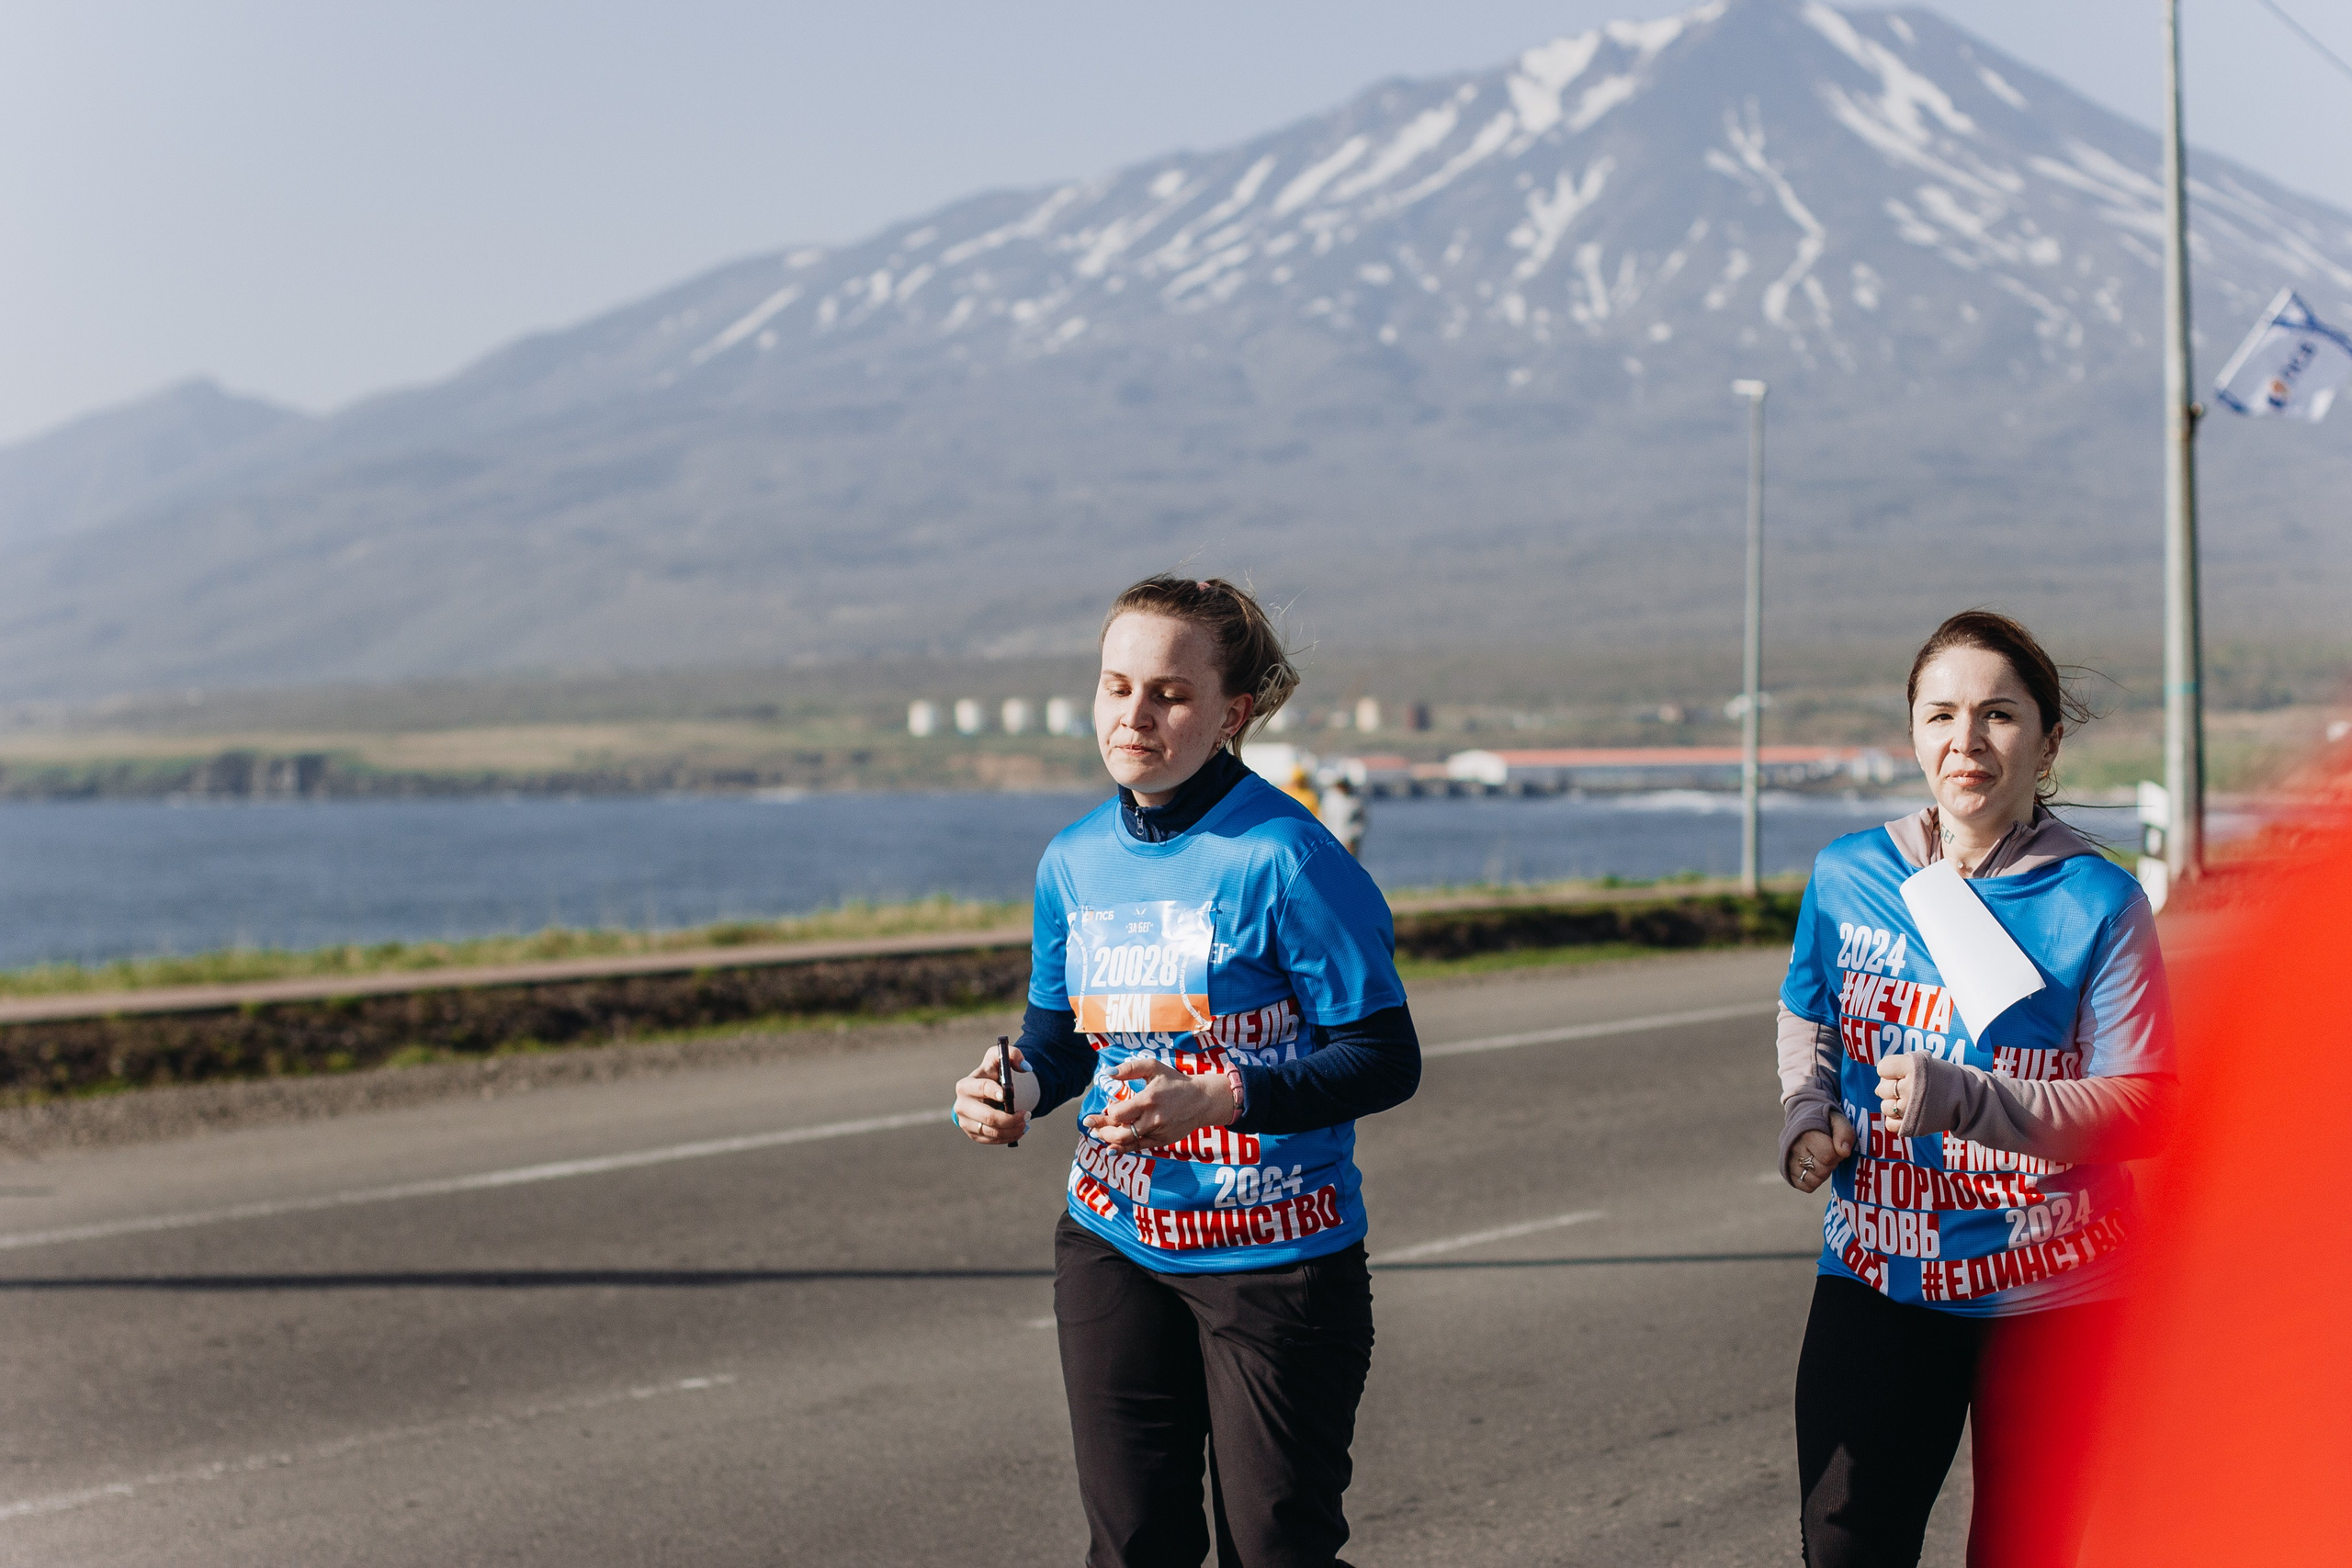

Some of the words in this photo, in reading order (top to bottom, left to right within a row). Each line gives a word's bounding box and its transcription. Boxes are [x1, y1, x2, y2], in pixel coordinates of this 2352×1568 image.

[1095, 910, 1114, 921] ПСБ
[1091, 944, 1180, 987] 20028
[1838, 922, 1907, 977] 2024
[1838, 970, 1955, 1034] #МЕЧТА
[1215, 1165, 1304, 1209] 2024
[1855, 1156, 2046, 1210] #ГОРДОСТЬ
[1136, 1184, 1343, 1251] #ЕДИНСТВО
[2006, 1189, 2094, 1249] 2024
